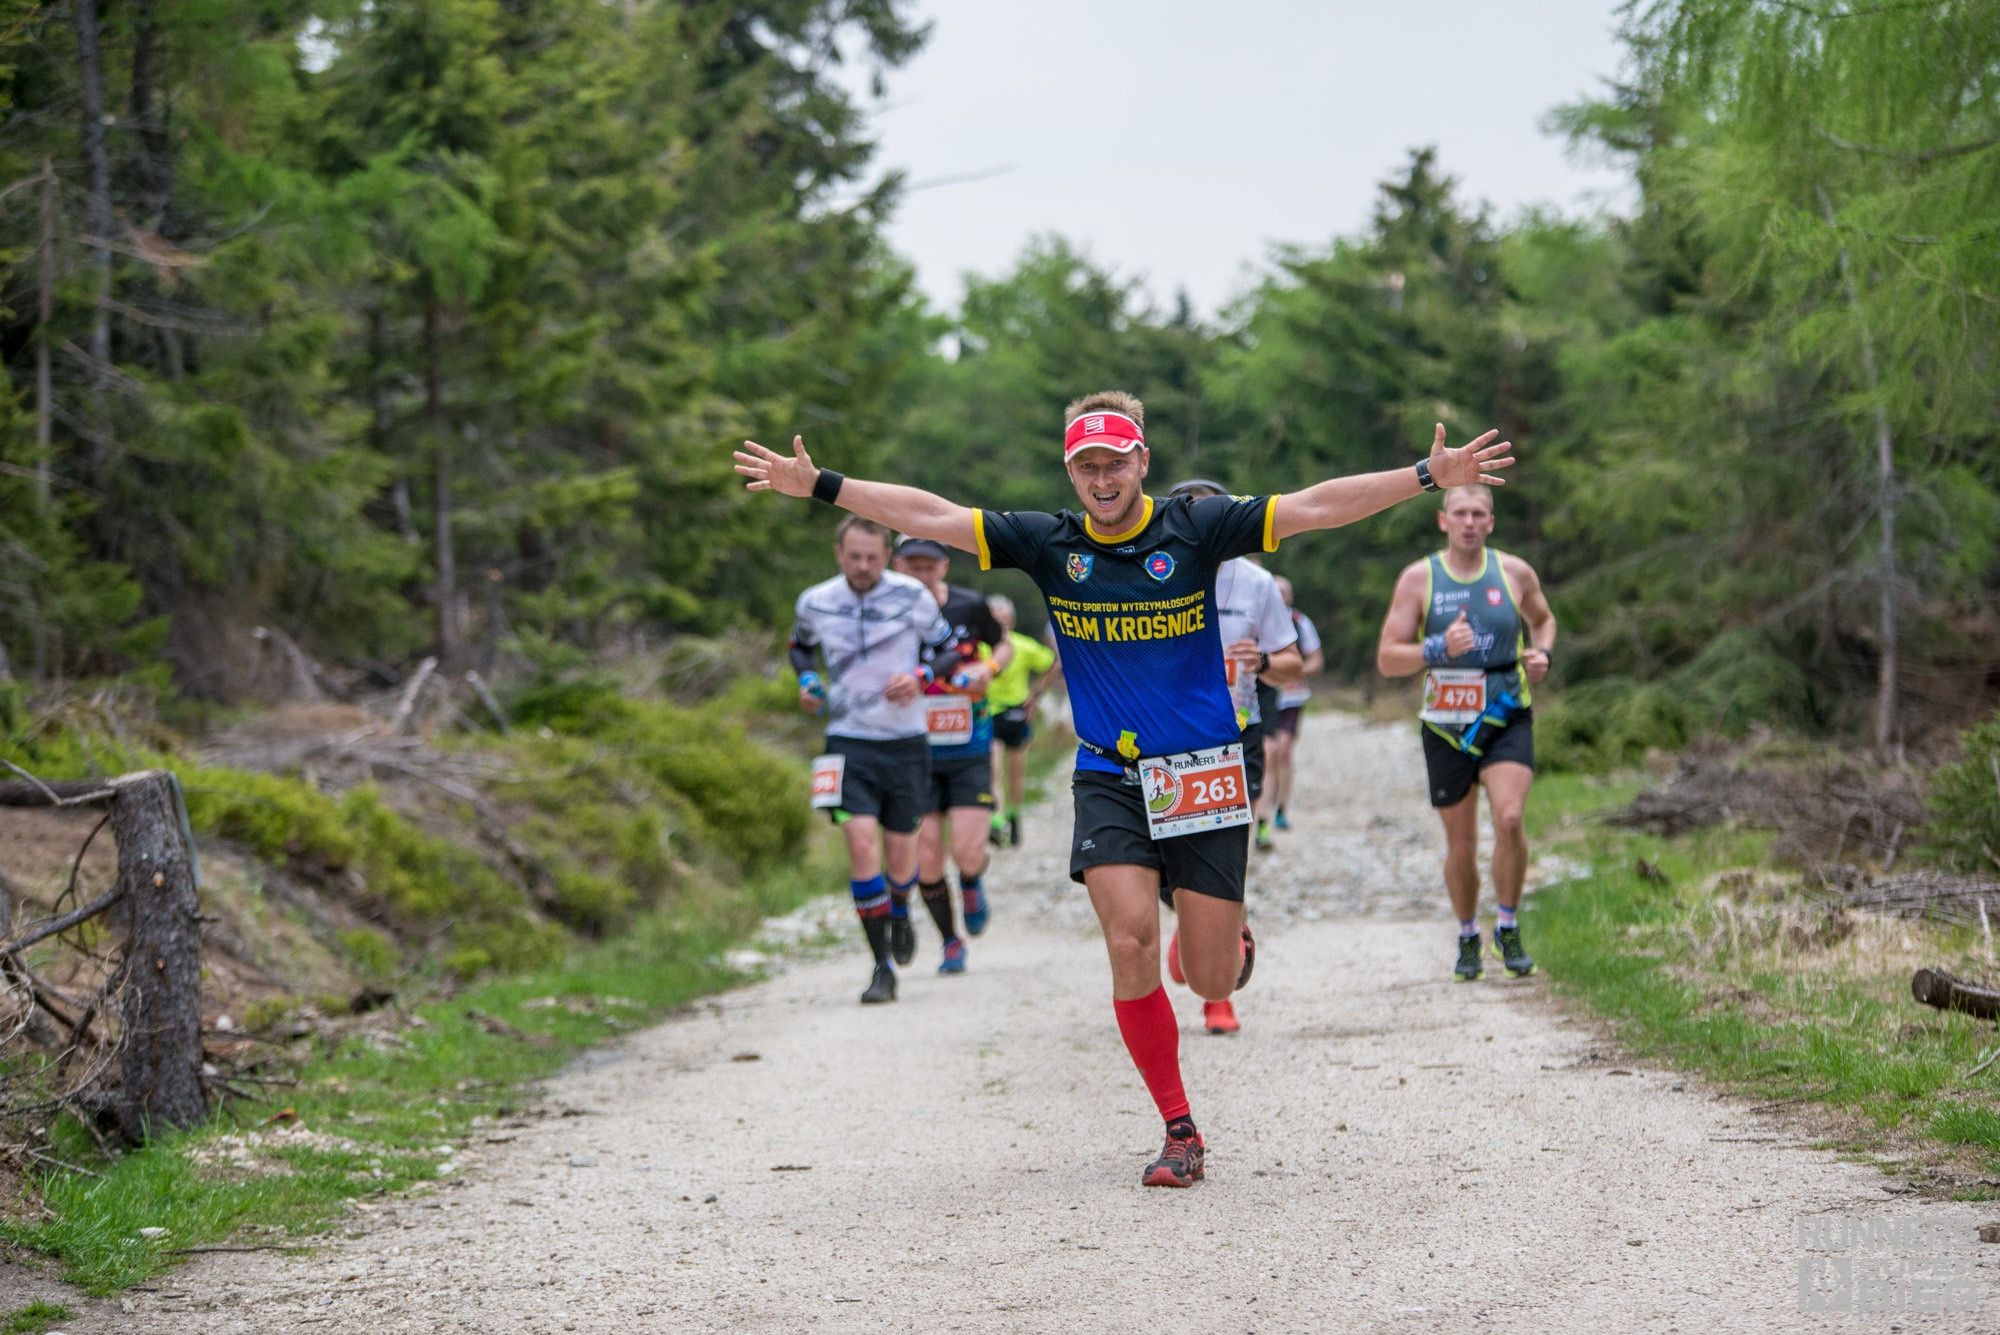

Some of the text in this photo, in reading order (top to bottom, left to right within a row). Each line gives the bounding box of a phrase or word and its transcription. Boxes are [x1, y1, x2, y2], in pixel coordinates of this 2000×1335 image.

[1082, 602, 1119, 612] SPORTÓW
[1053, 604, 1205, 641] TEAM KROŚNICE
[1444, 688, 1478, 707] 470
[1191, 775, 1237, 806] 263
